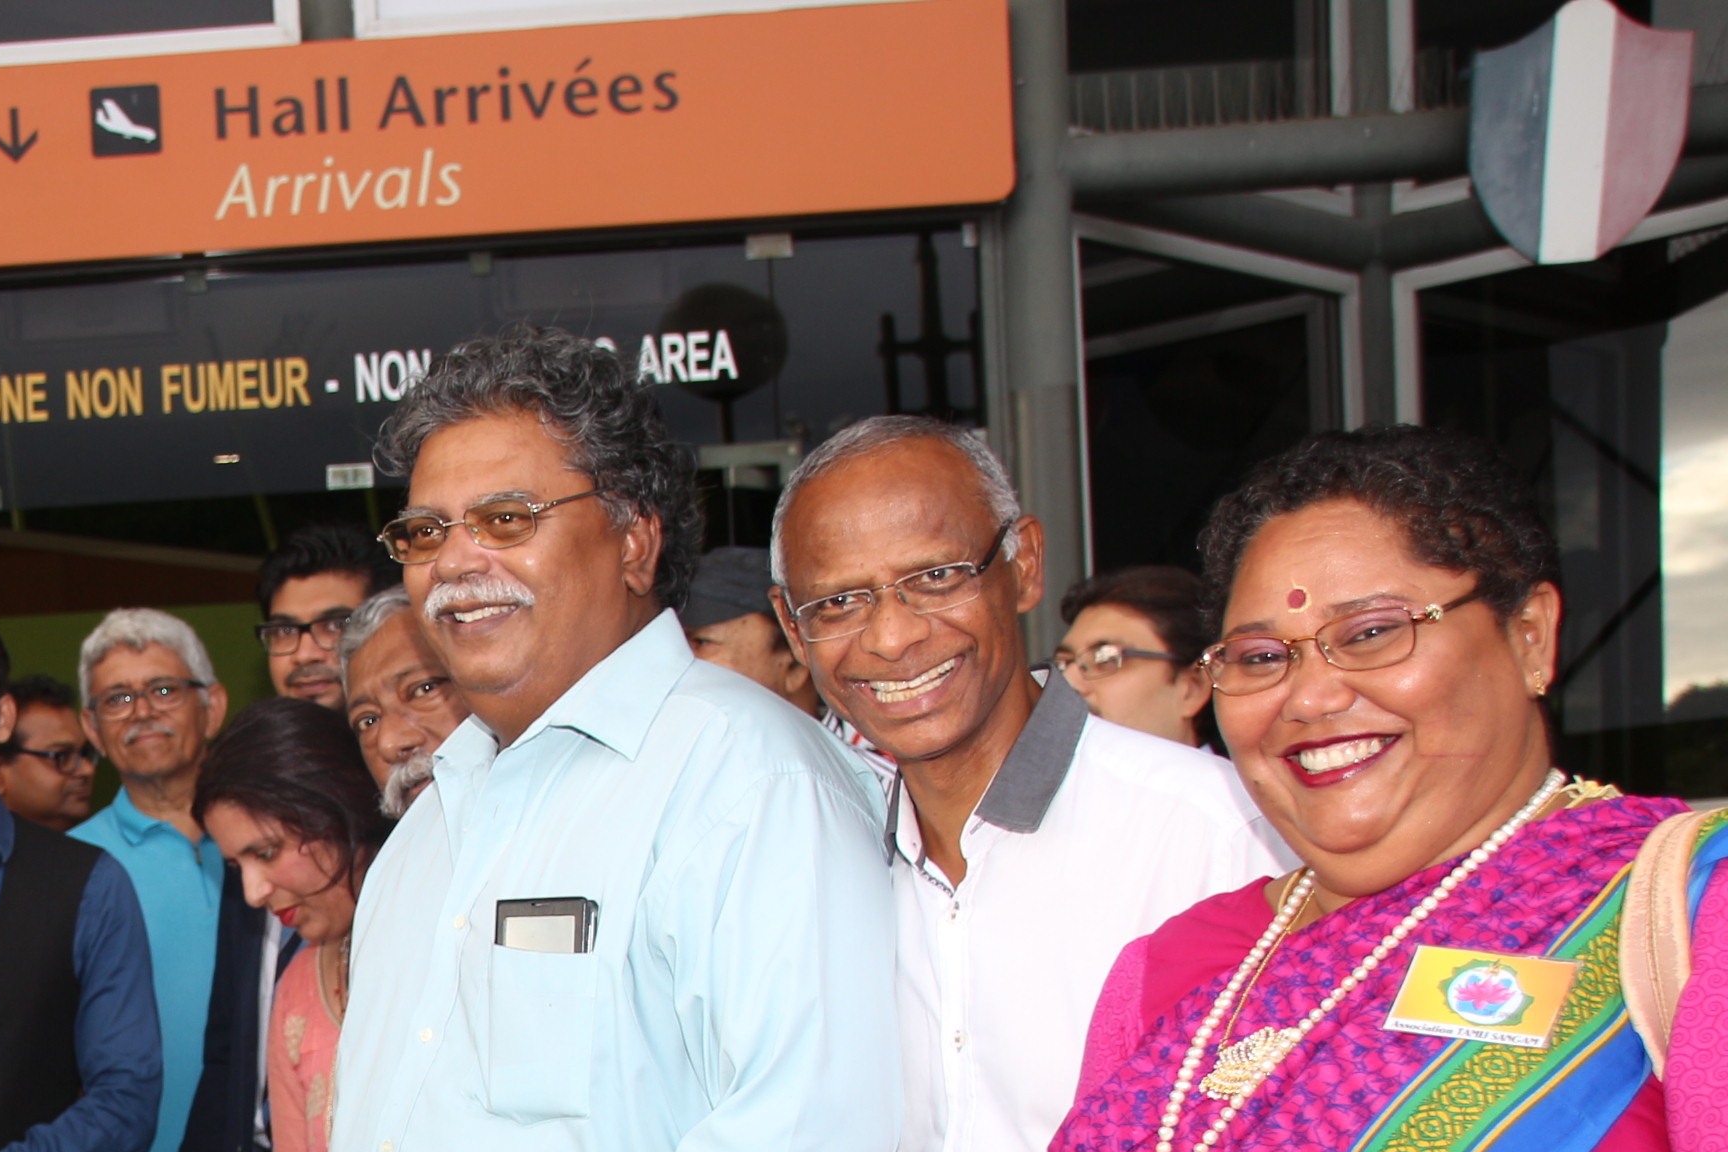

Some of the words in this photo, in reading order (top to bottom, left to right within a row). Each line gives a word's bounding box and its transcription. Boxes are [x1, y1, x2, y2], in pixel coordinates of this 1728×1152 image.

[214, 76, 351, 140] Hall
[377, 57, 681, 130] Arrivées
[213, 147, 464, 221] Arrivals
[66, 367, 144, 420] NON
[161, 356, 312, 414] FUMEUR
[637, 329, 739, 385] AREA
